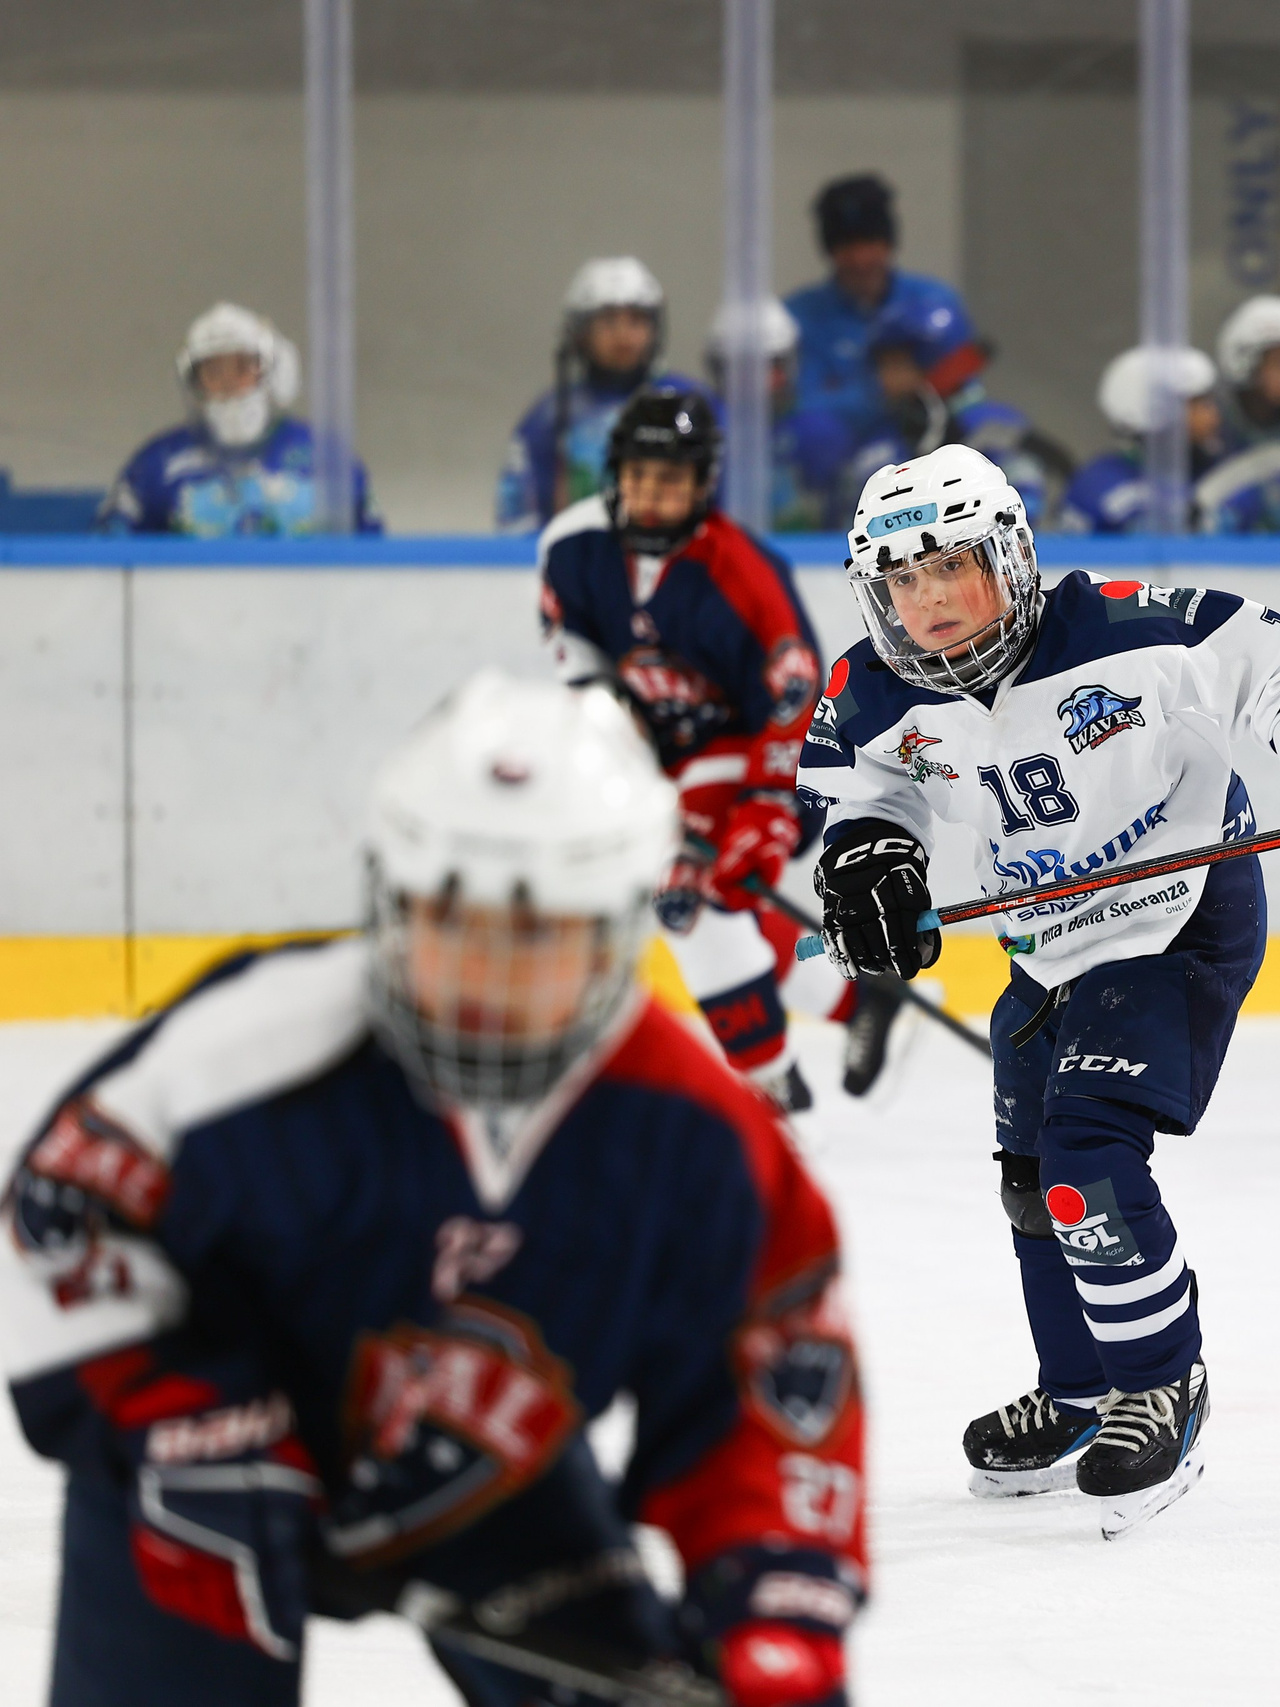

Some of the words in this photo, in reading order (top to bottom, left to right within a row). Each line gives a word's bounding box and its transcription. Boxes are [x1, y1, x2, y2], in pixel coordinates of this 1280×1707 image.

[884, 509, 924, 529] OTTO
[1069, 710, 1145, 754] WAVES
[977, 753, 1080, 837] 18
[994, 895, 1038, 910] TRUE
[1109, 879, 1190, 919] Speranza
[1057, 1054, 1149, 1078] CCM
